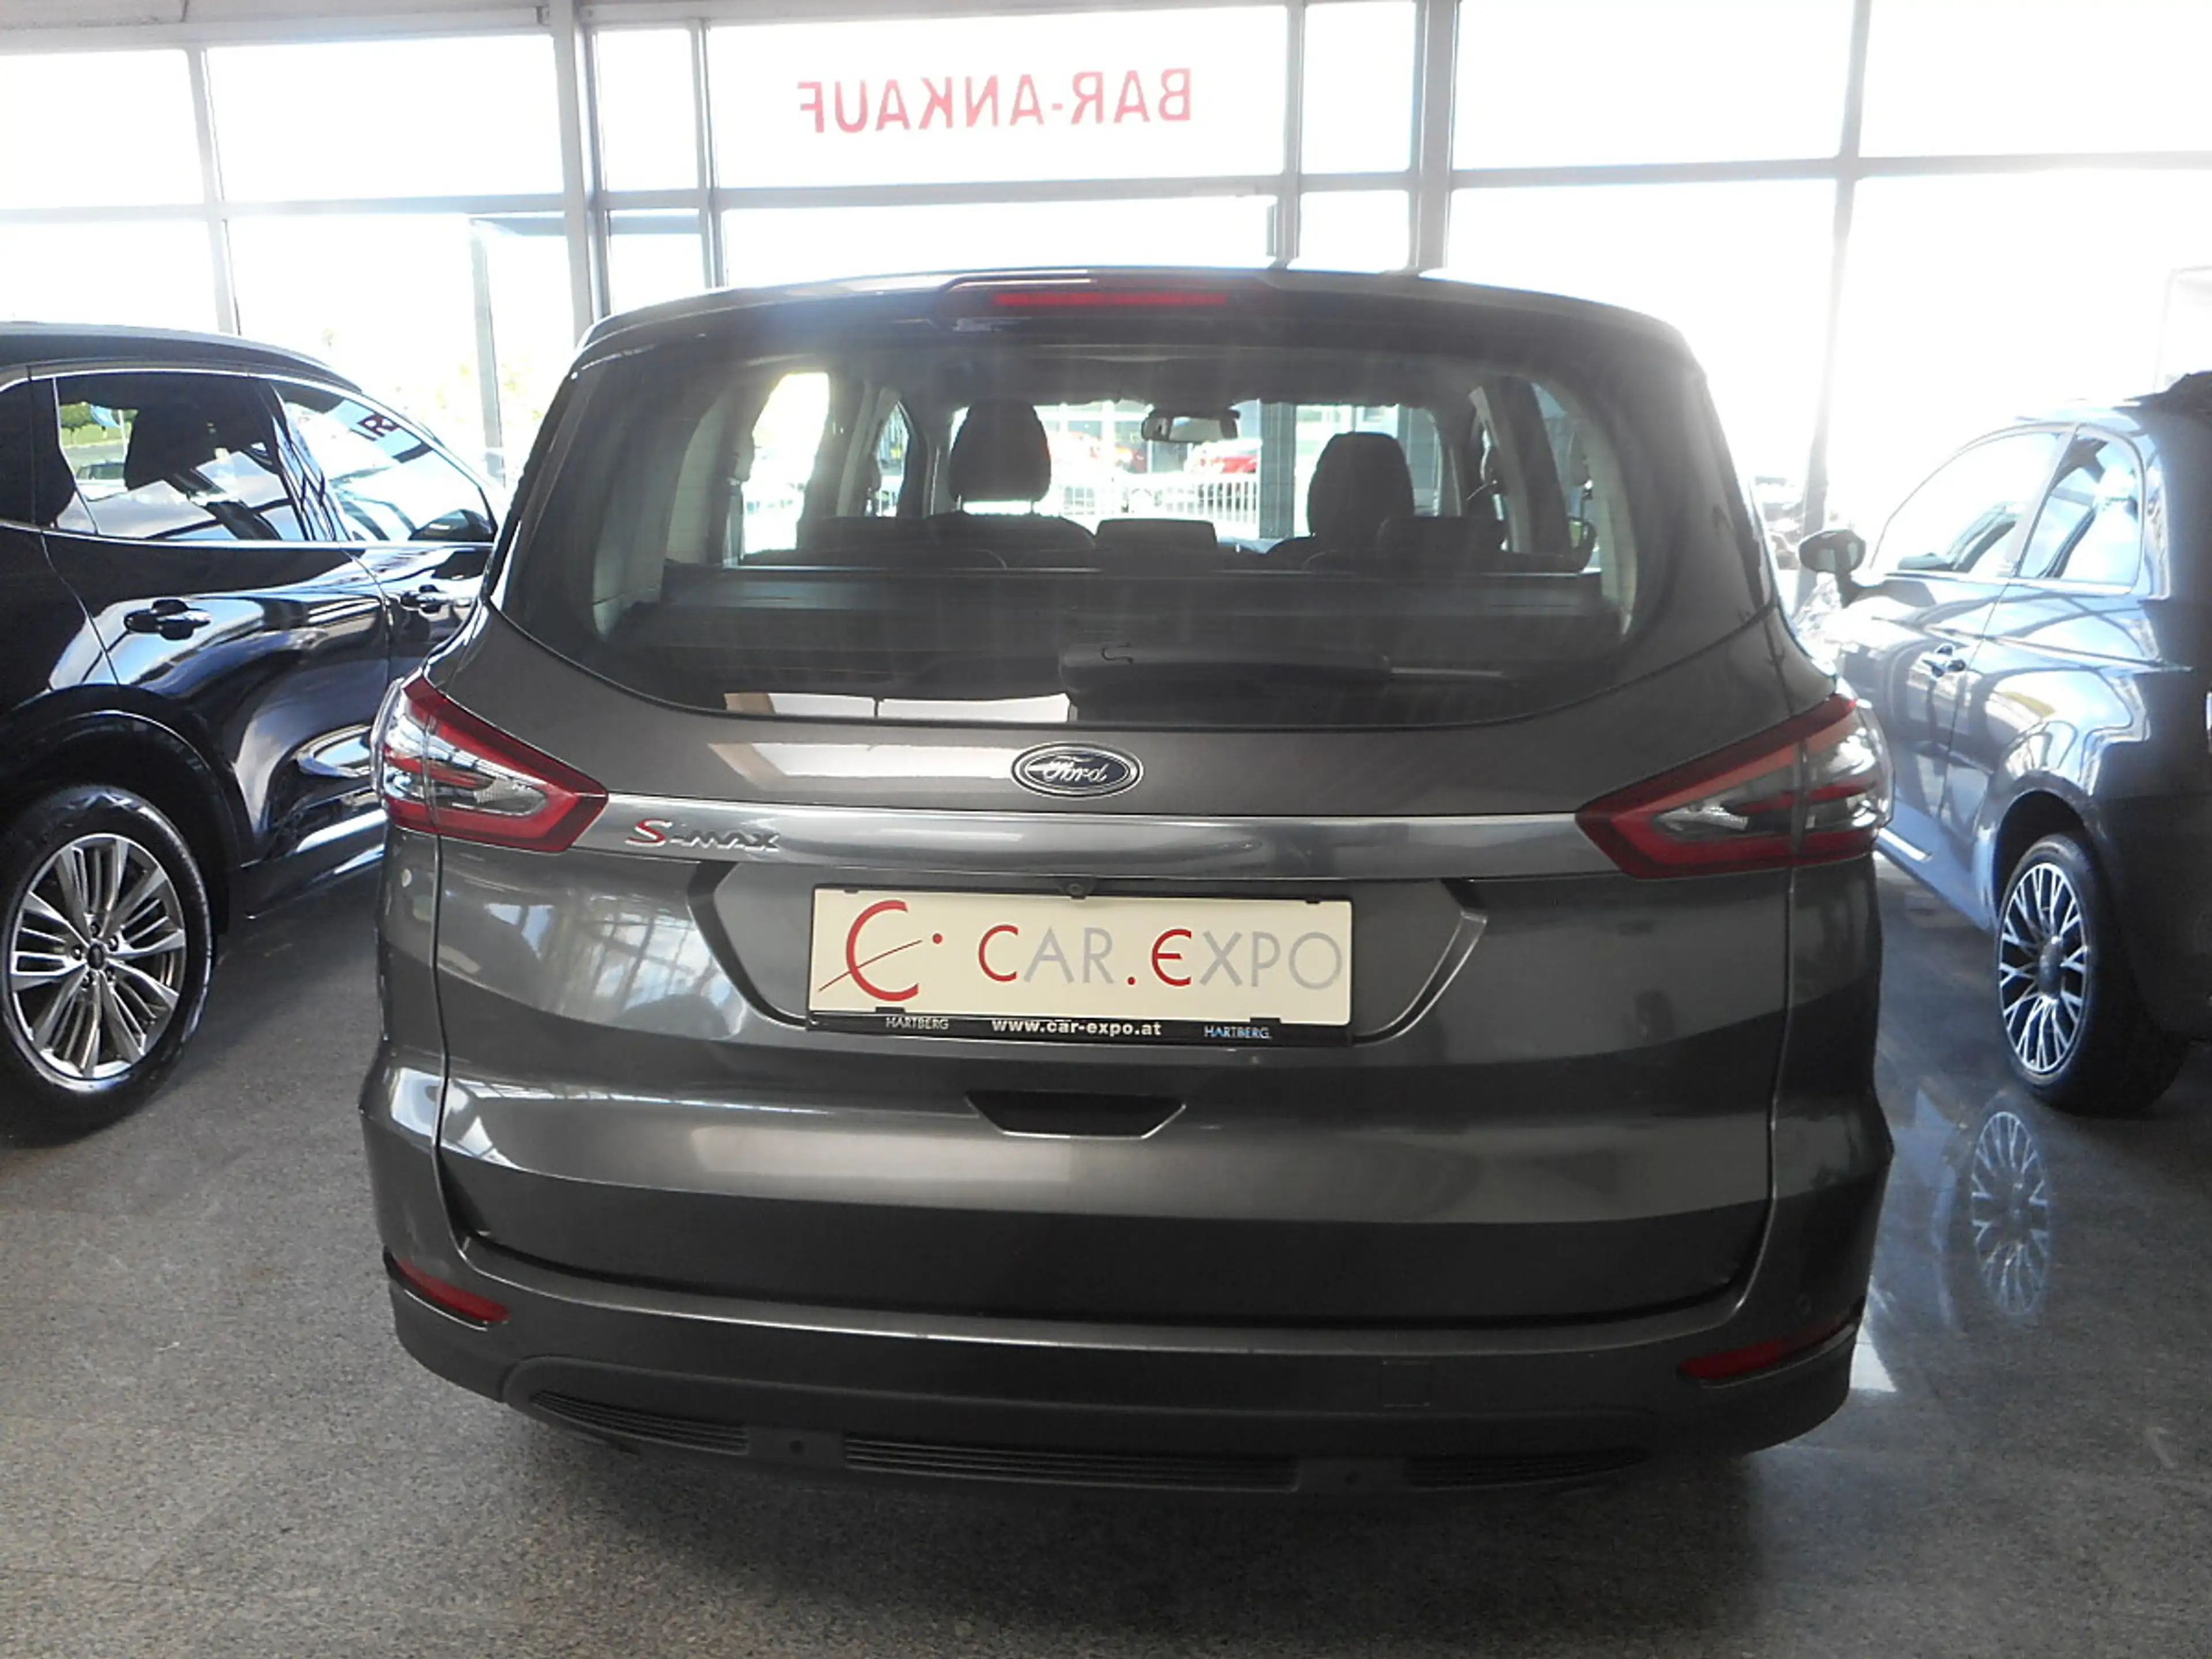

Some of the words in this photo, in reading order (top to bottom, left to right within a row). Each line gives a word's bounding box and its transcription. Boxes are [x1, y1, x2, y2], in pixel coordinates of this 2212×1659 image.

[1043, 755, 1109, 782] Ford
[885, 1016, 950, 1031] HARTBERG
[991, 1019, 1162, 1037] www.car-expo.at
[1203, 1025, 1271, 1039] HARTBERG
